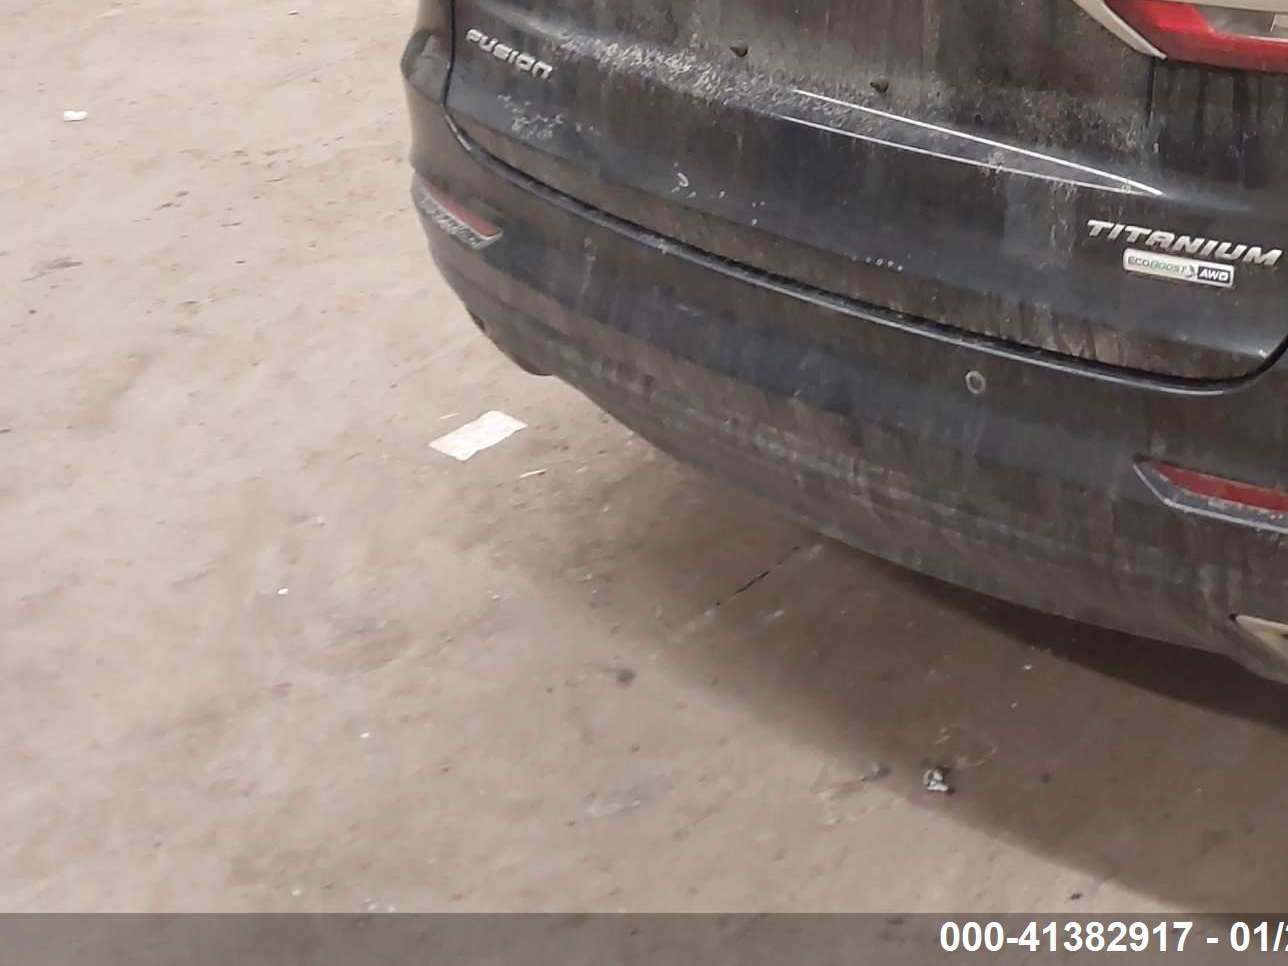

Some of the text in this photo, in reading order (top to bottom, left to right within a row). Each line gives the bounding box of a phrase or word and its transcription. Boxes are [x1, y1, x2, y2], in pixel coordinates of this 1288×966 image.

[465, 28, 553, 80] FUSION
[1086, 219, 1283, 267] TITANIUM
[1198, 267, 1230, 282] AWD
